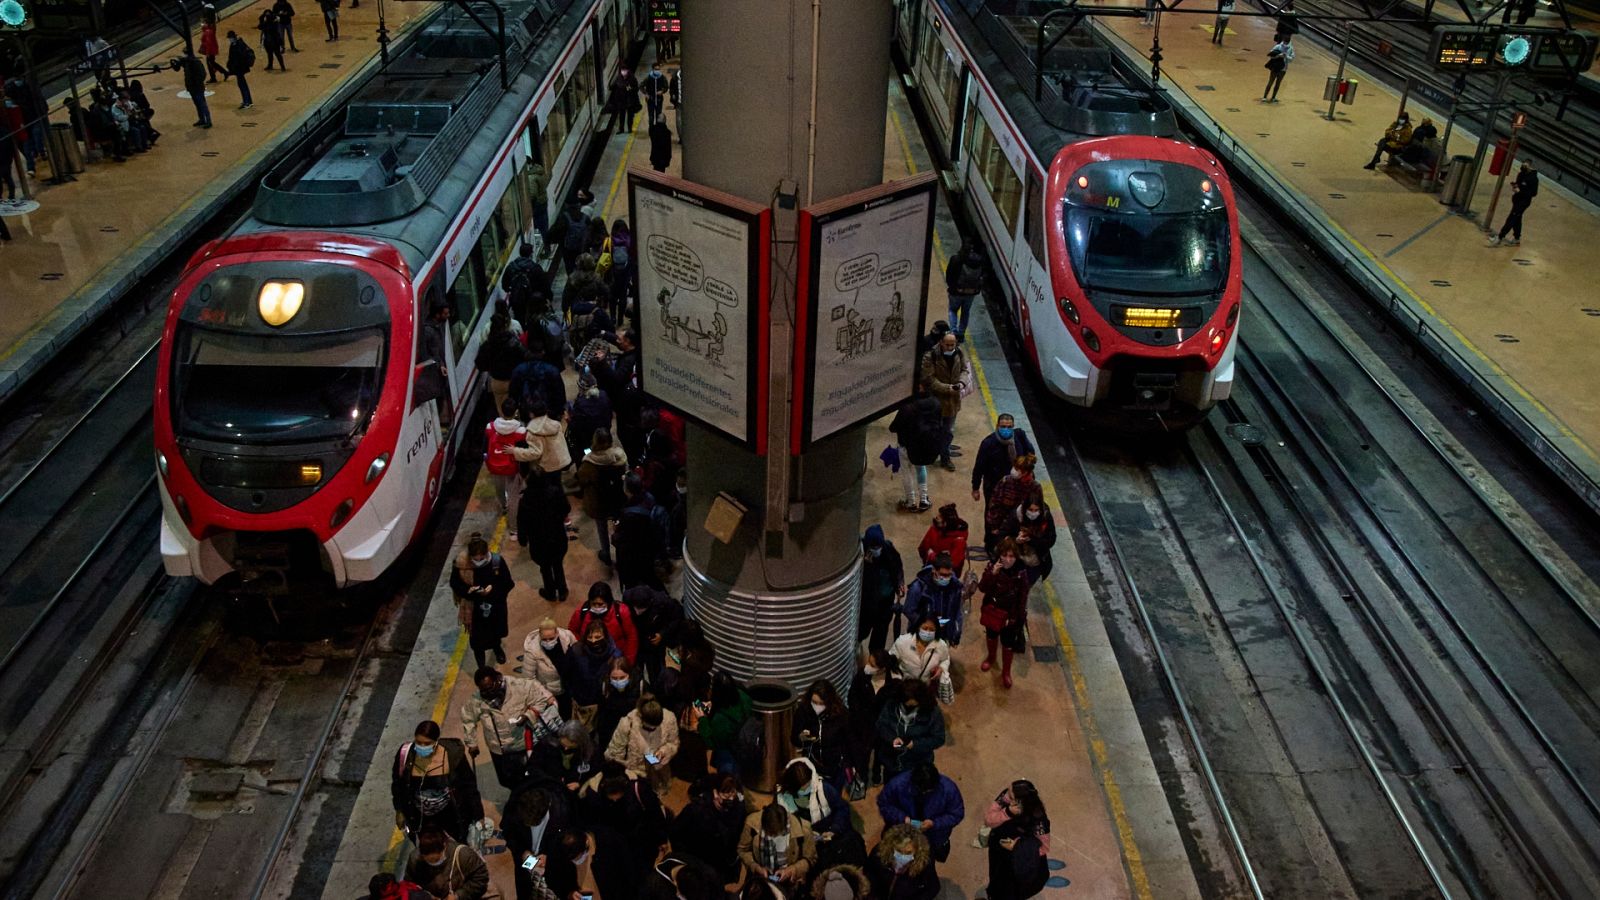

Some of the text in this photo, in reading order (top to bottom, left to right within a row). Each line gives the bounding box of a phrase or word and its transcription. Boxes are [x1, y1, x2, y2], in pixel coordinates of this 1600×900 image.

[1106, 196, 1120, 208] M
[1028, 276, 1045, 303] renfe
[650, 369, 739, 418] #IgualdeProfesionales
[655, 358, 732, 400] #IgualdeDiferentes
[406, 419, 432, 464] renfe
